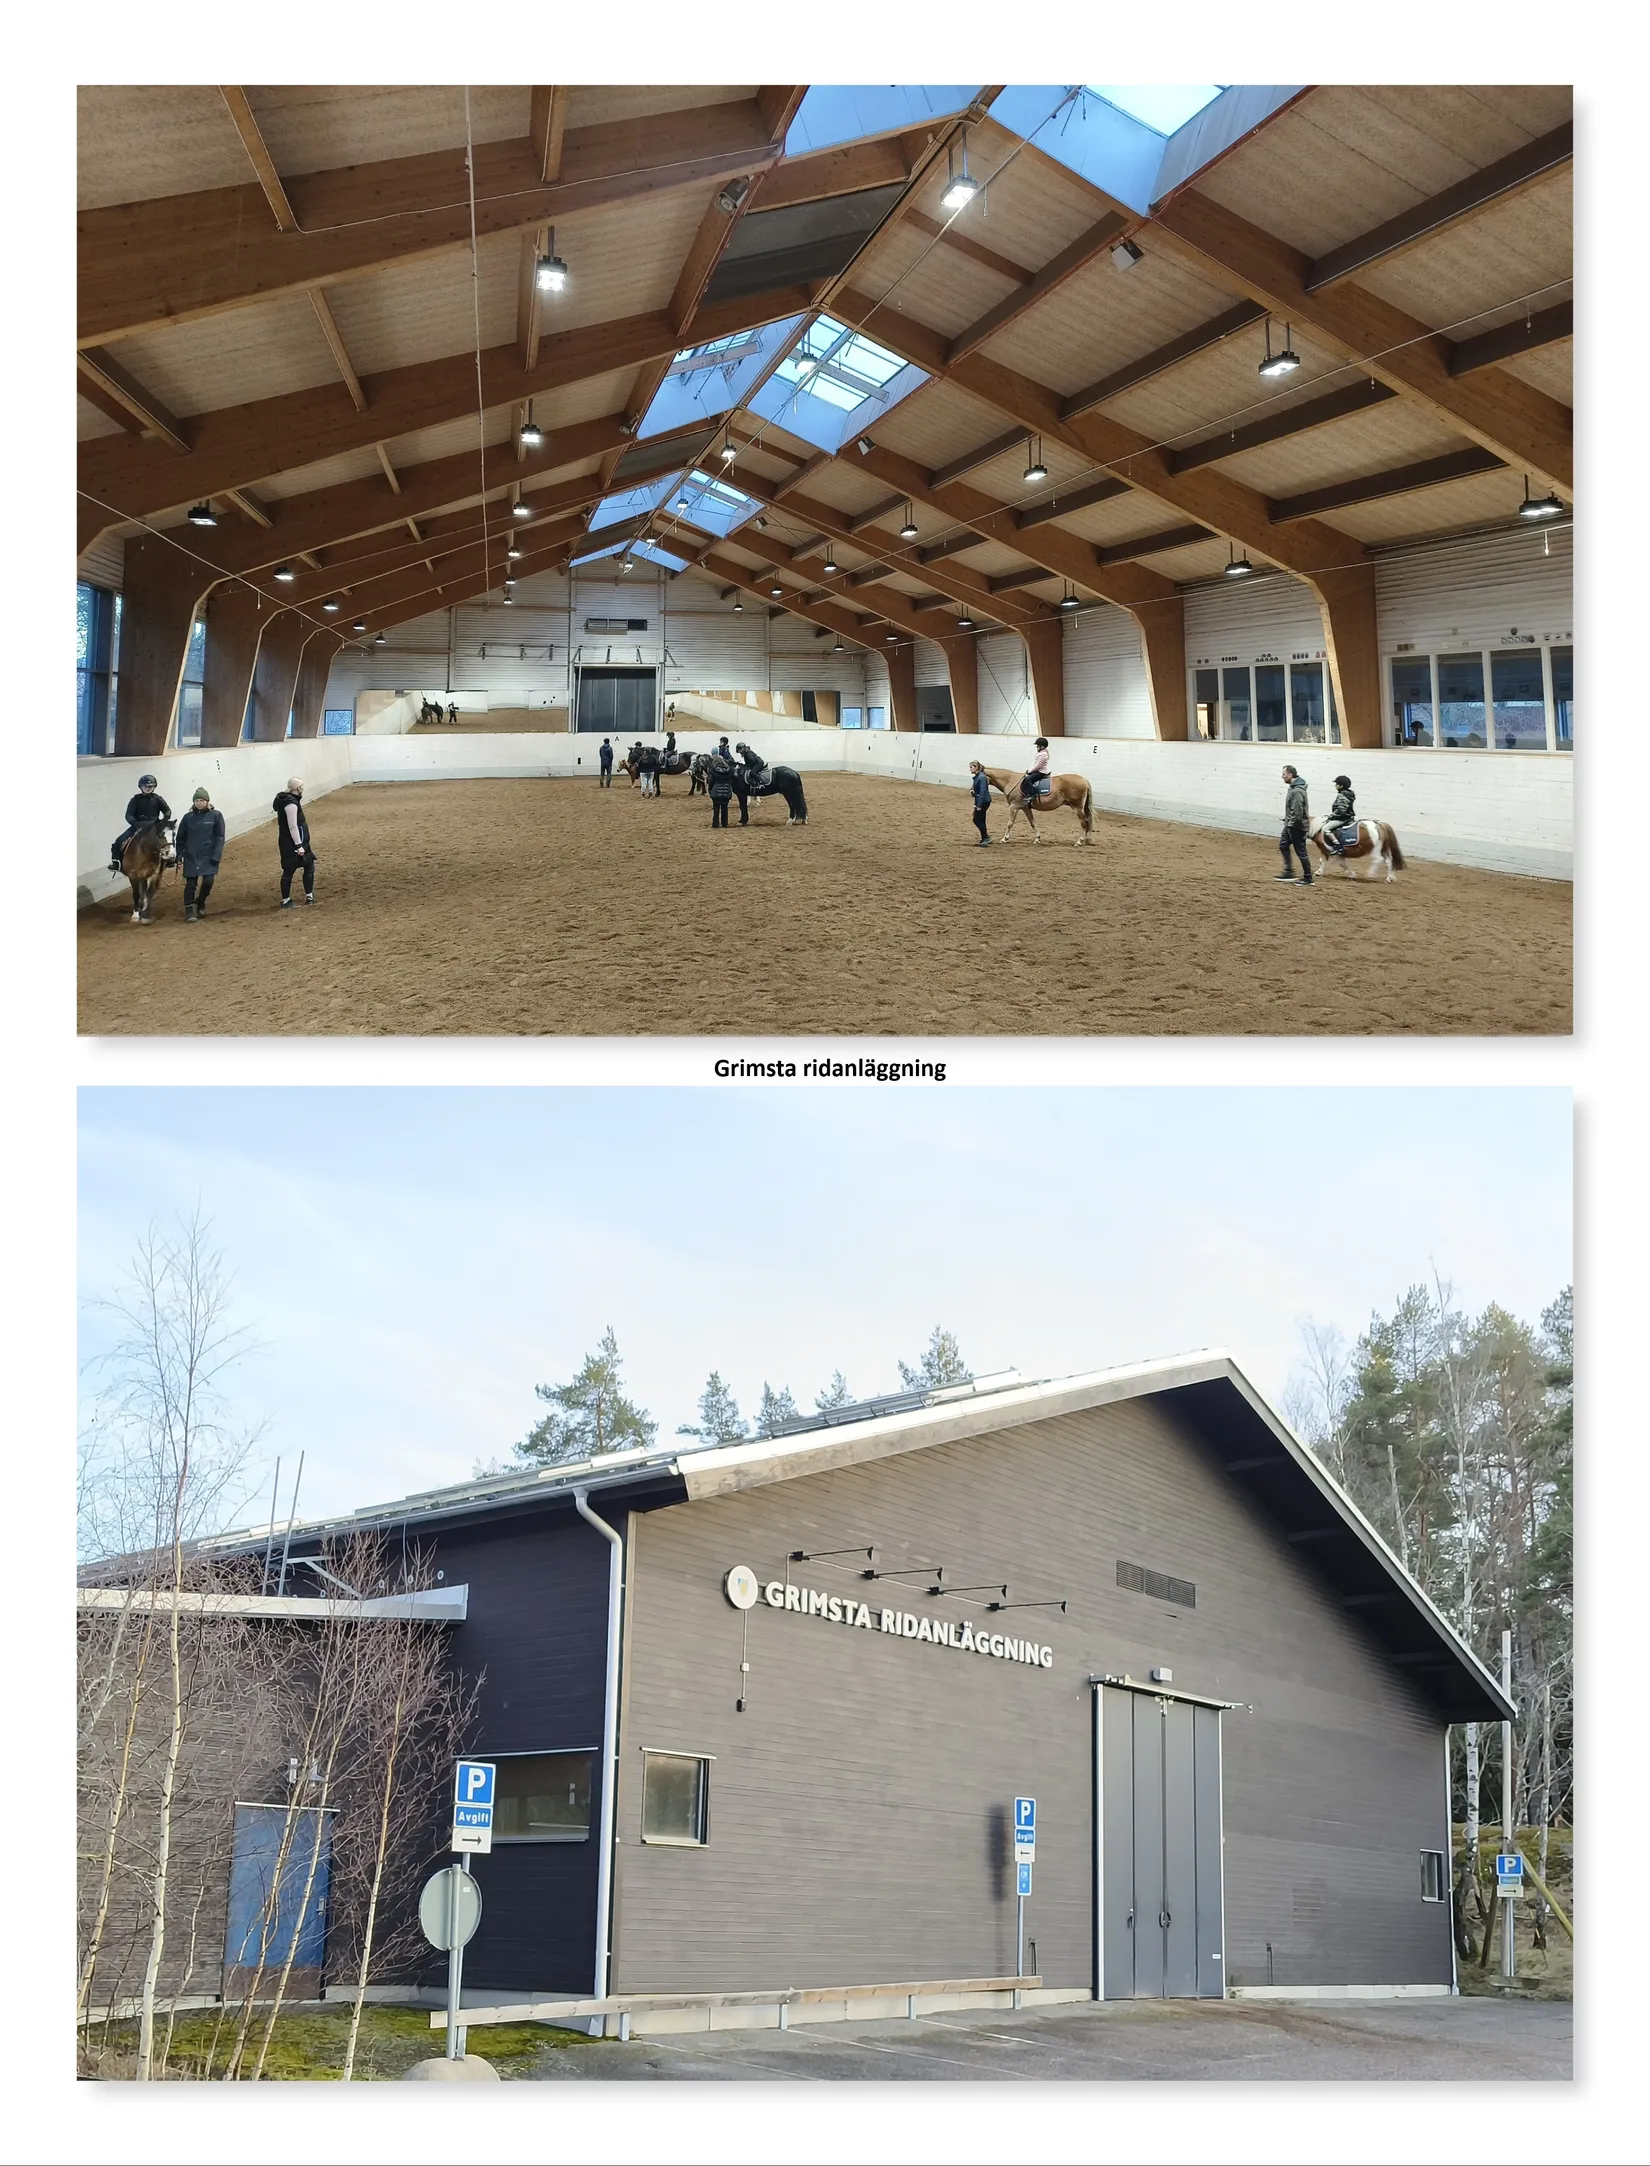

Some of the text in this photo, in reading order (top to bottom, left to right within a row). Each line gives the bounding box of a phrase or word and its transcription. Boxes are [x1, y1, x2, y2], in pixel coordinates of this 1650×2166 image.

[1092, 745, 1098, 754] E
[765, 1581, 1053, 1668] GRIMSTA RIDANLÄGGNING
[467, 1767, 486, 1800] P
[458, 1811, 489, 1824] Avgift
[1020, 1801, 1031, 1825] P
[1504, 1857, 1517, 1873] P
